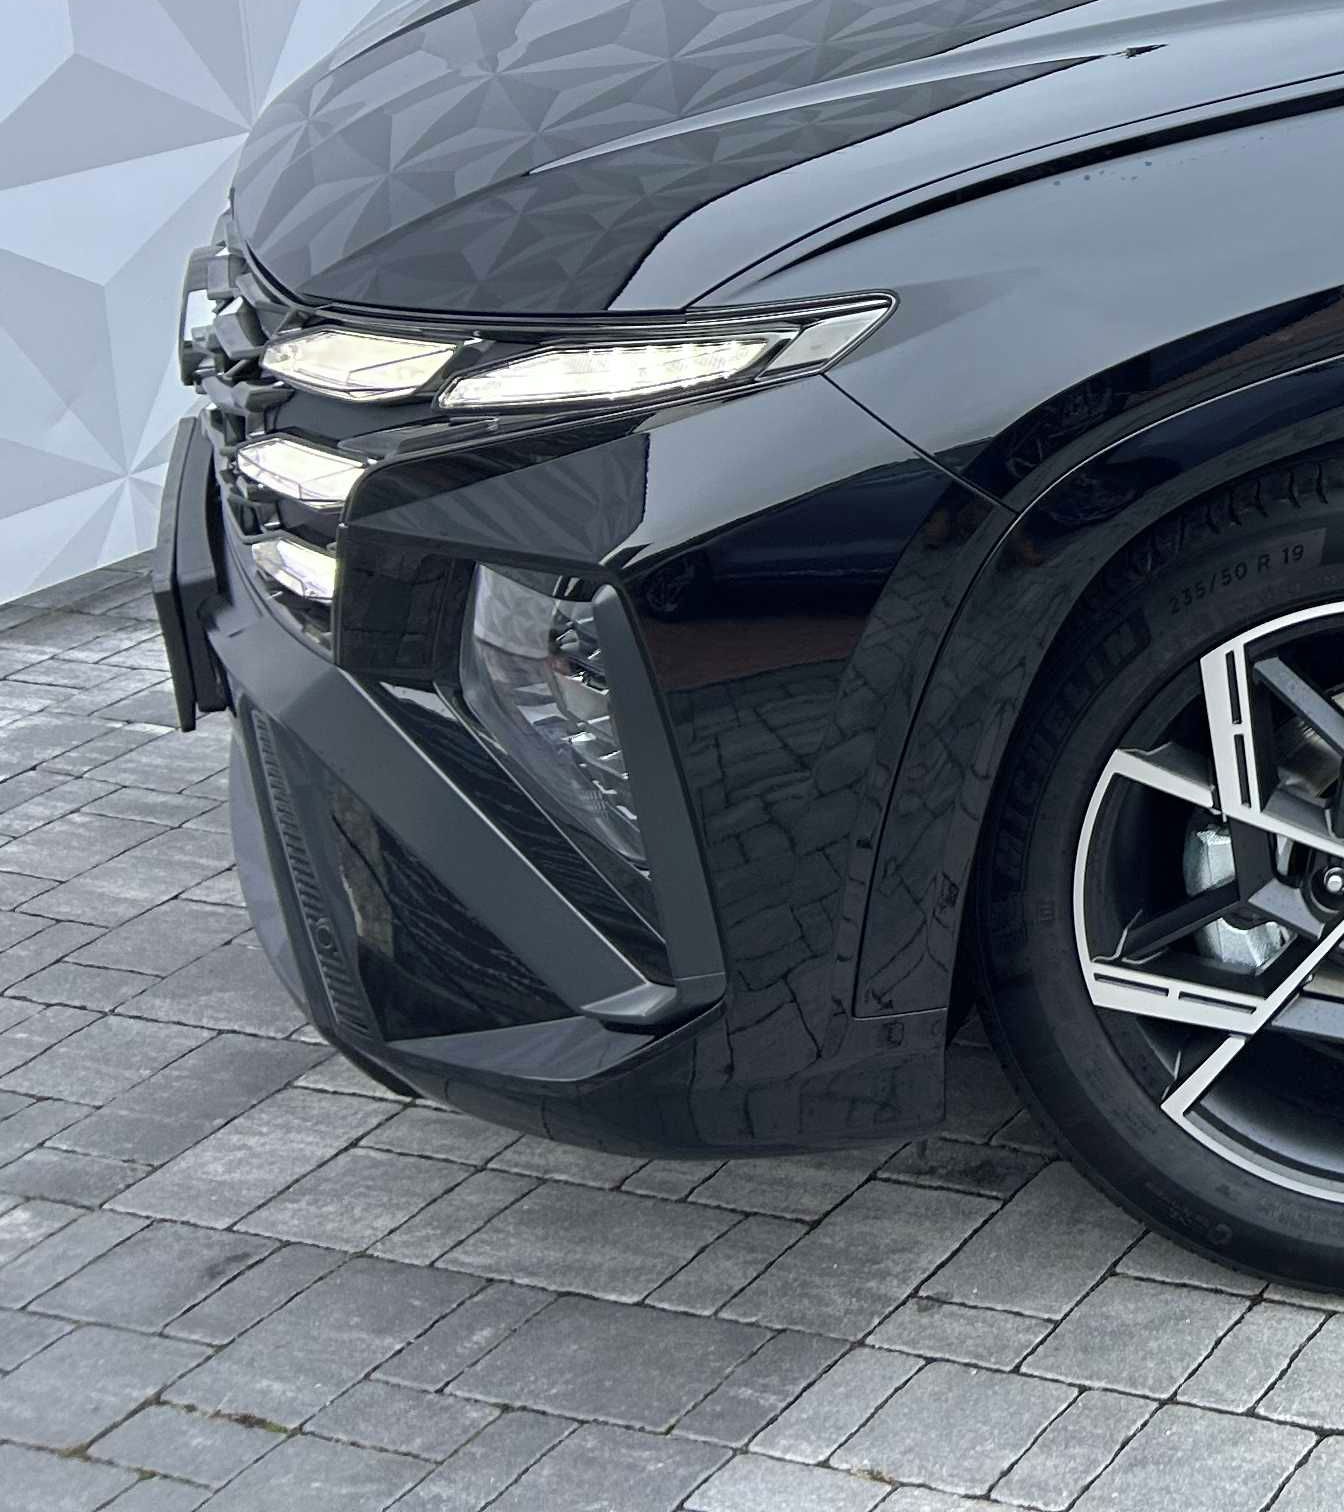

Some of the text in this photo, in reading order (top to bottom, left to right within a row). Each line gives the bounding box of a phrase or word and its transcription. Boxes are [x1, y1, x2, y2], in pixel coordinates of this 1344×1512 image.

[1168, 560, 1249, 615] 235/50
[1256, 553, 1272, 574] R
[1280, 543, 1305, 565] 19
